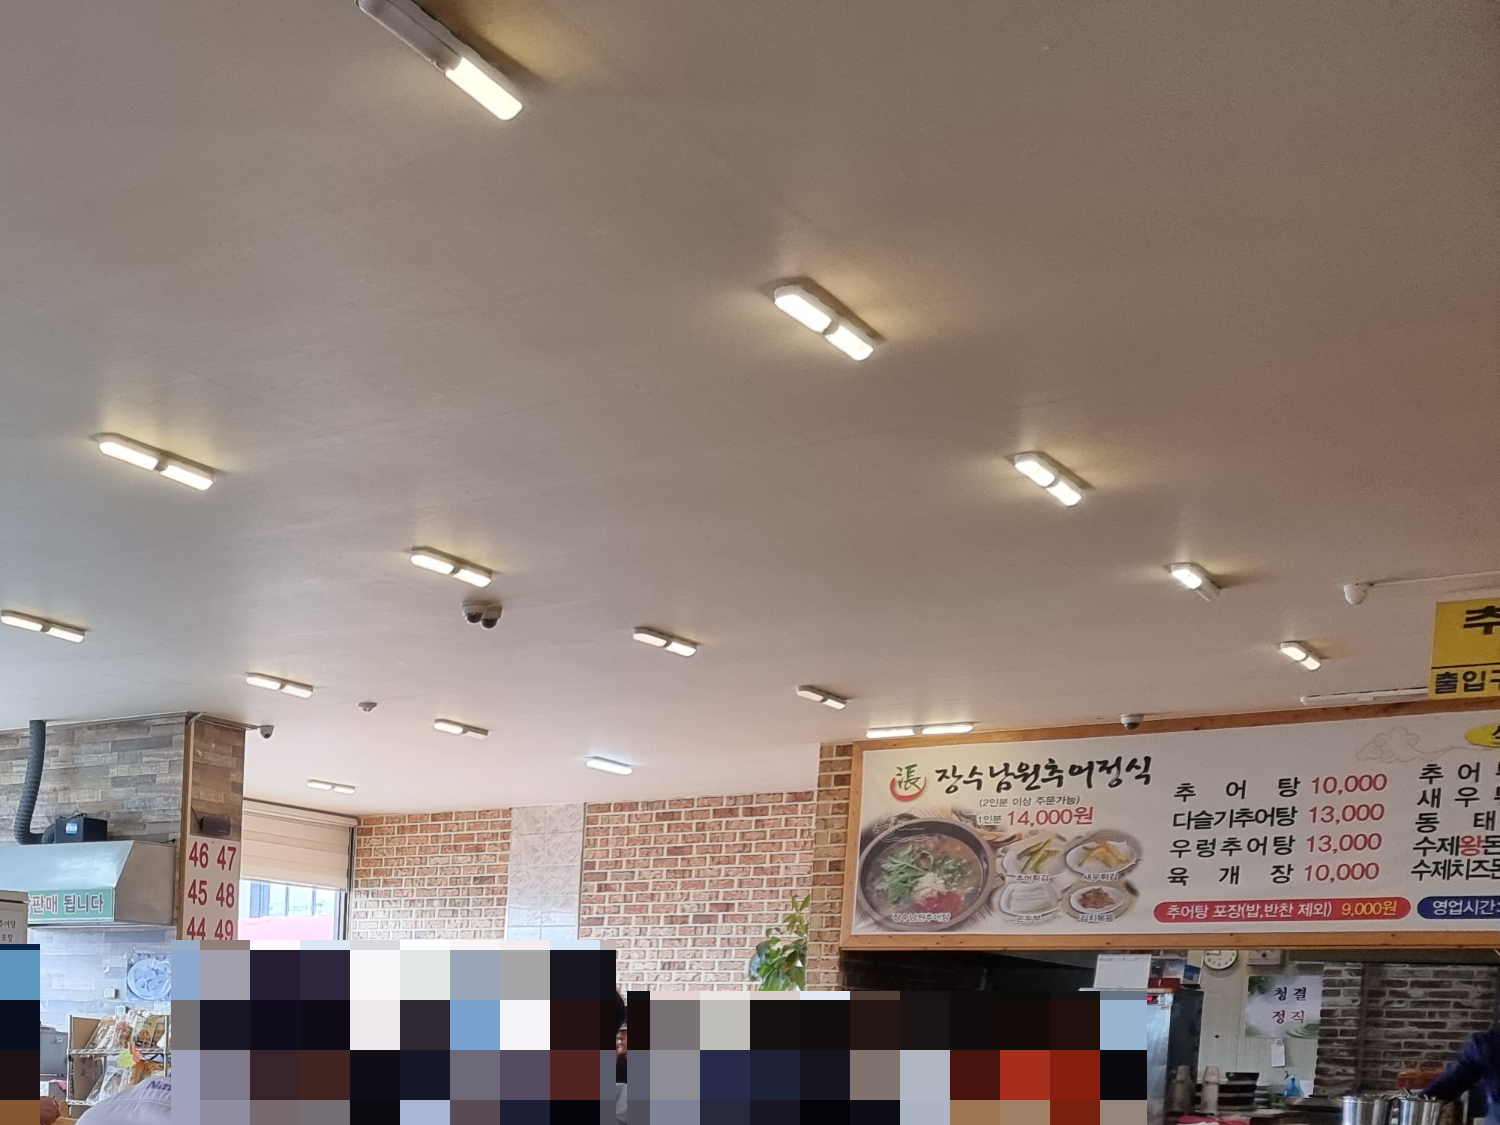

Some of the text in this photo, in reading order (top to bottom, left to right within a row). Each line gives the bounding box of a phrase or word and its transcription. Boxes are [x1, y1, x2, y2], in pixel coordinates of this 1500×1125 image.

[934, 756, 1152, 795] 장수남원추어정식
[1311, 773, 1388, 797] 10,000
[1012, 796, 1032, 807] 이상
[1007, 806, 1094, 827] 14,000원
[1172, 803, 1385, 831] 다슬기추어탕 13,000
[1306, 832, 1382, 855] 13,000
[189, 841, 237, 871] 46 47
[1304, 862, 1380, 884] 10,000
[63, 893, 104, 914] 됩니다
[188, 879, 235, 908] 45 48
[1166, 904, 1209, 919] 추어탕
[1297, 901, 1333, 918] 제외)
[1341, 900, 1398, 916] 9,000원
[186, 916, 234, 940] 44 49
